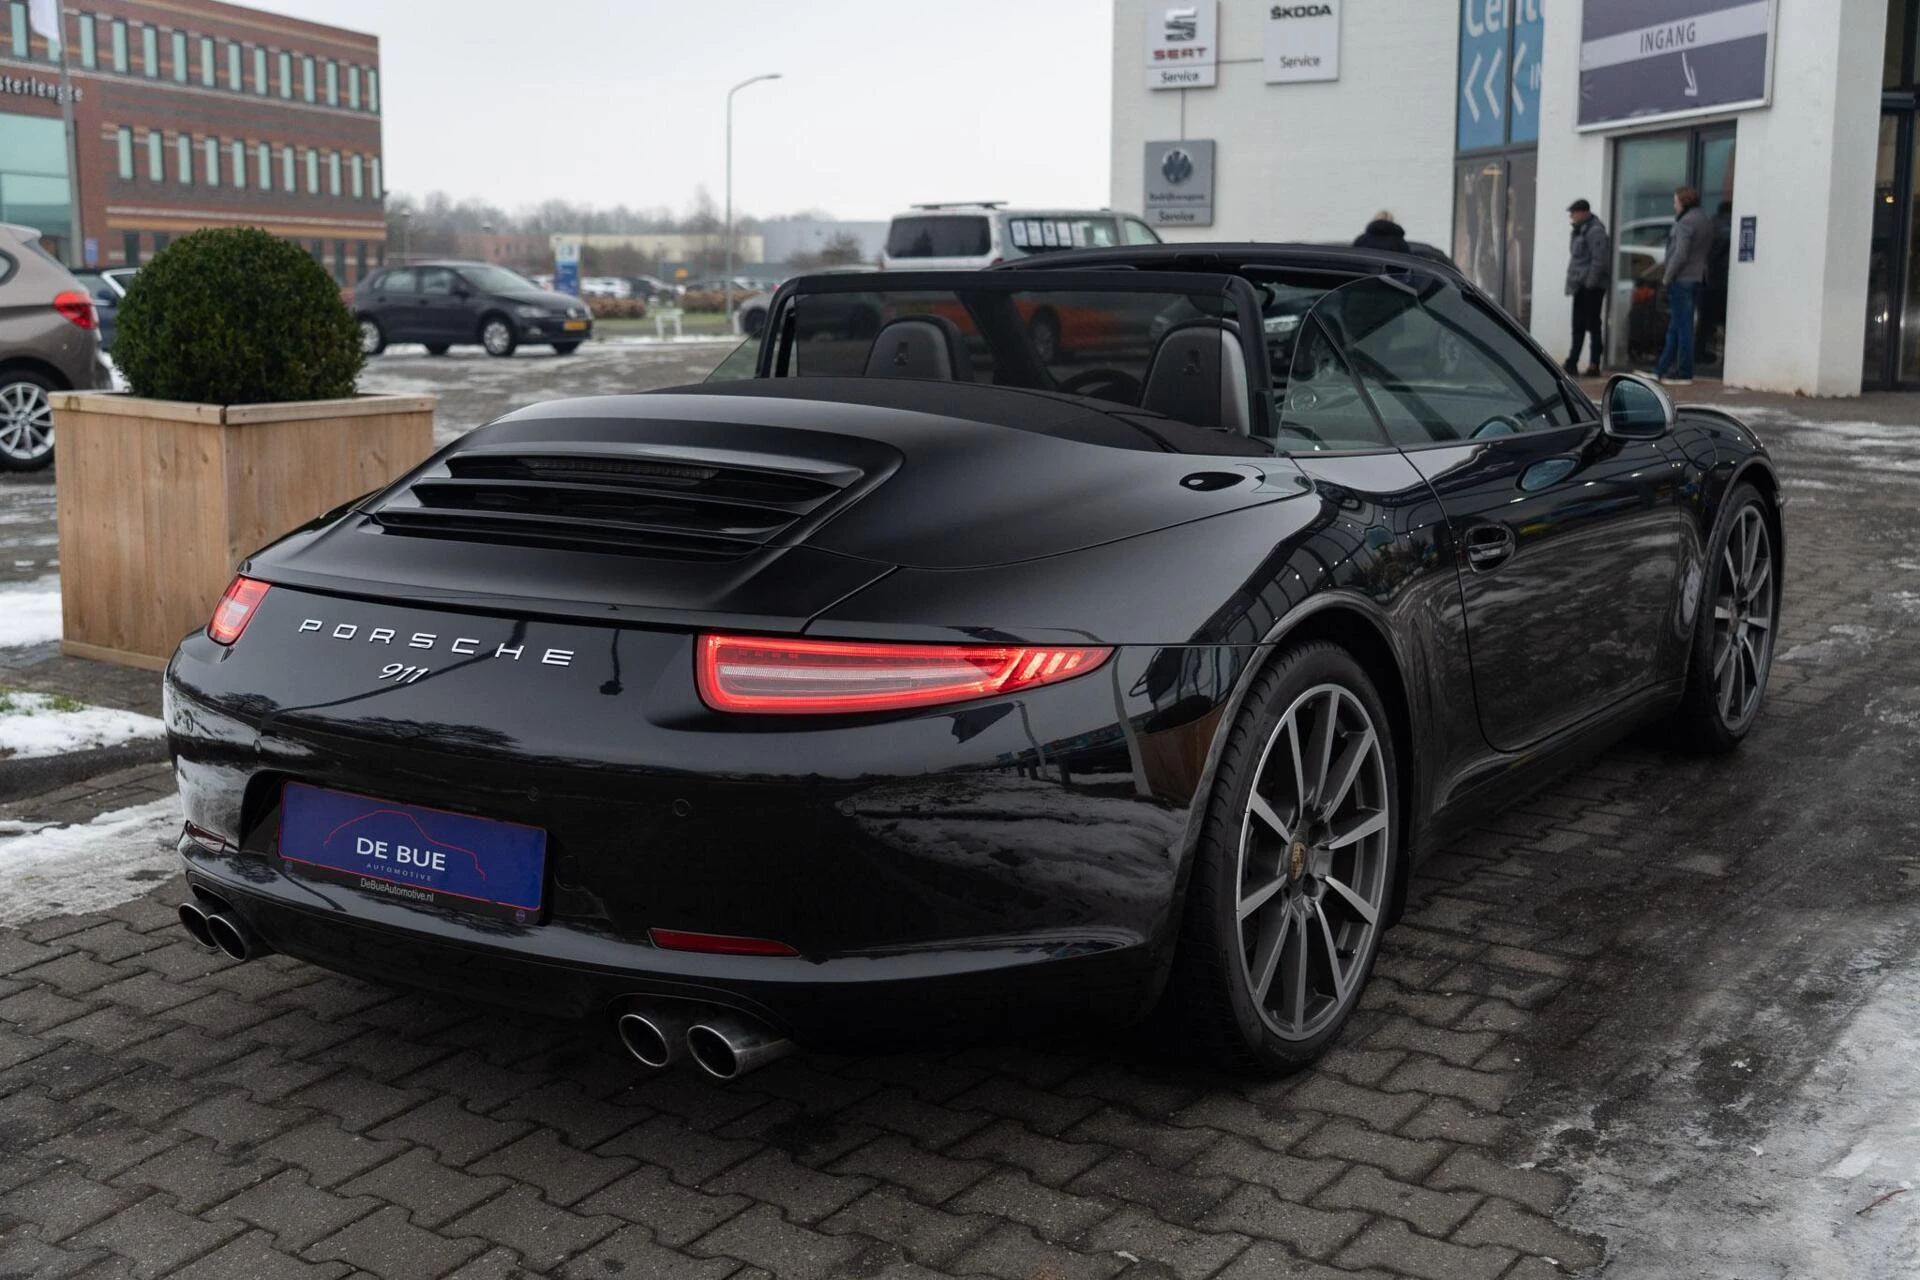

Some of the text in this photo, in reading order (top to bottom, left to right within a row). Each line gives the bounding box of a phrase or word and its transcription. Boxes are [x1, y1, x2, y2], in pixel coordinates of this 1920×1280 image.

[1465, 0, 1544, 37] Cent
[1639, 21, 1697, 54] INGANG
[1153, 47, 1207, 61] SEAT
[1279, 55, 1321, 69] Service
[1160, 69, 1200, 84] Service
[1158, 209, 1195, 222] Service
[298, 618, 575, 667] PORSCHE
[378, 662, 430, 684] 911
[356, 836, 446, 871] DE BUE
[366, 863, 432, 882] AUTOMOTIVE
[360, 877, 434, 902] DeBueAutomotive.nl
